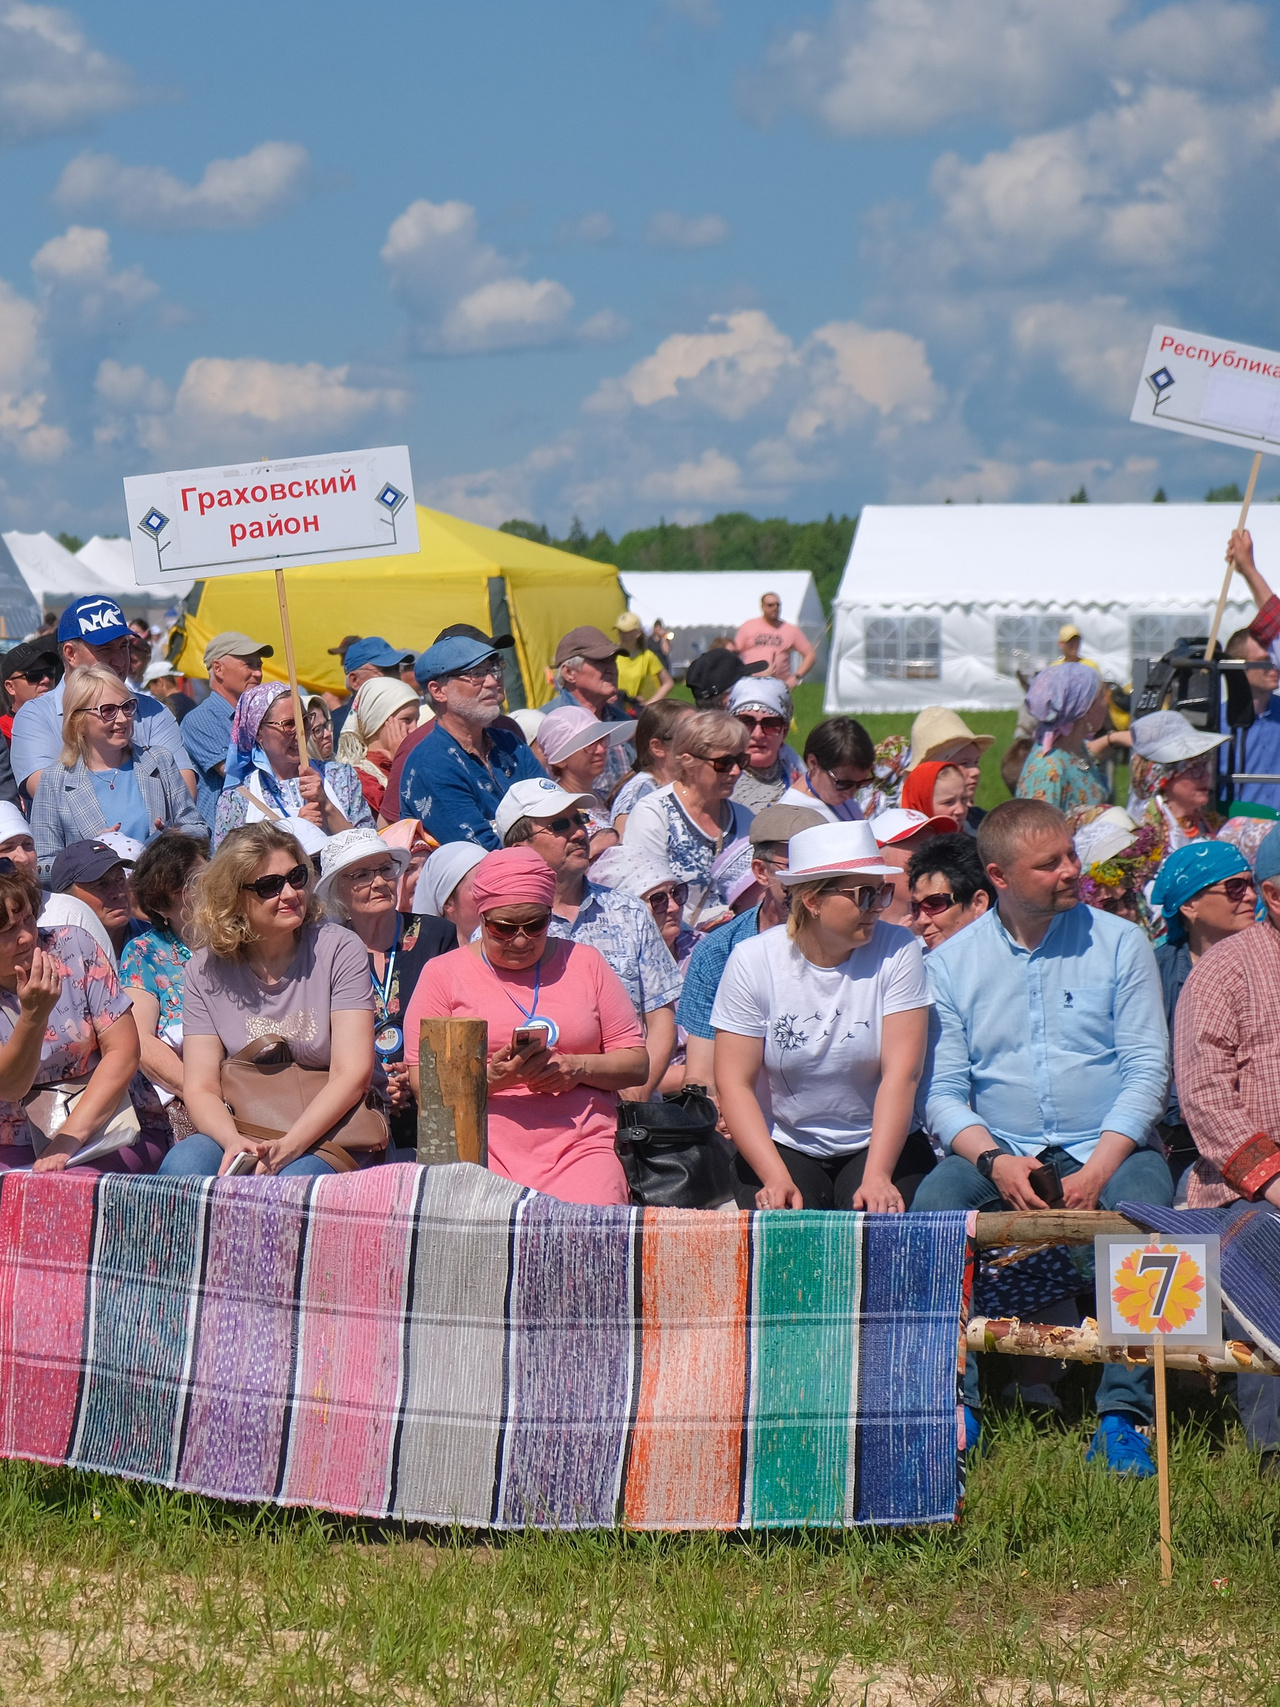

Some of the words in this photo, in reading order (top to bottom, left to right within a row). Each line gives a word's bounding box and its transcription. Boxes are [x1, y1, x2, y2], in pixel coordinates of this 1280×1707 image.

[1160, 335, 1280, 379] Республика
[180, 468, 357, 515] Граховский
[229, 512, 320, 547] район
[1138, 1254, 1180, 1317] 7
